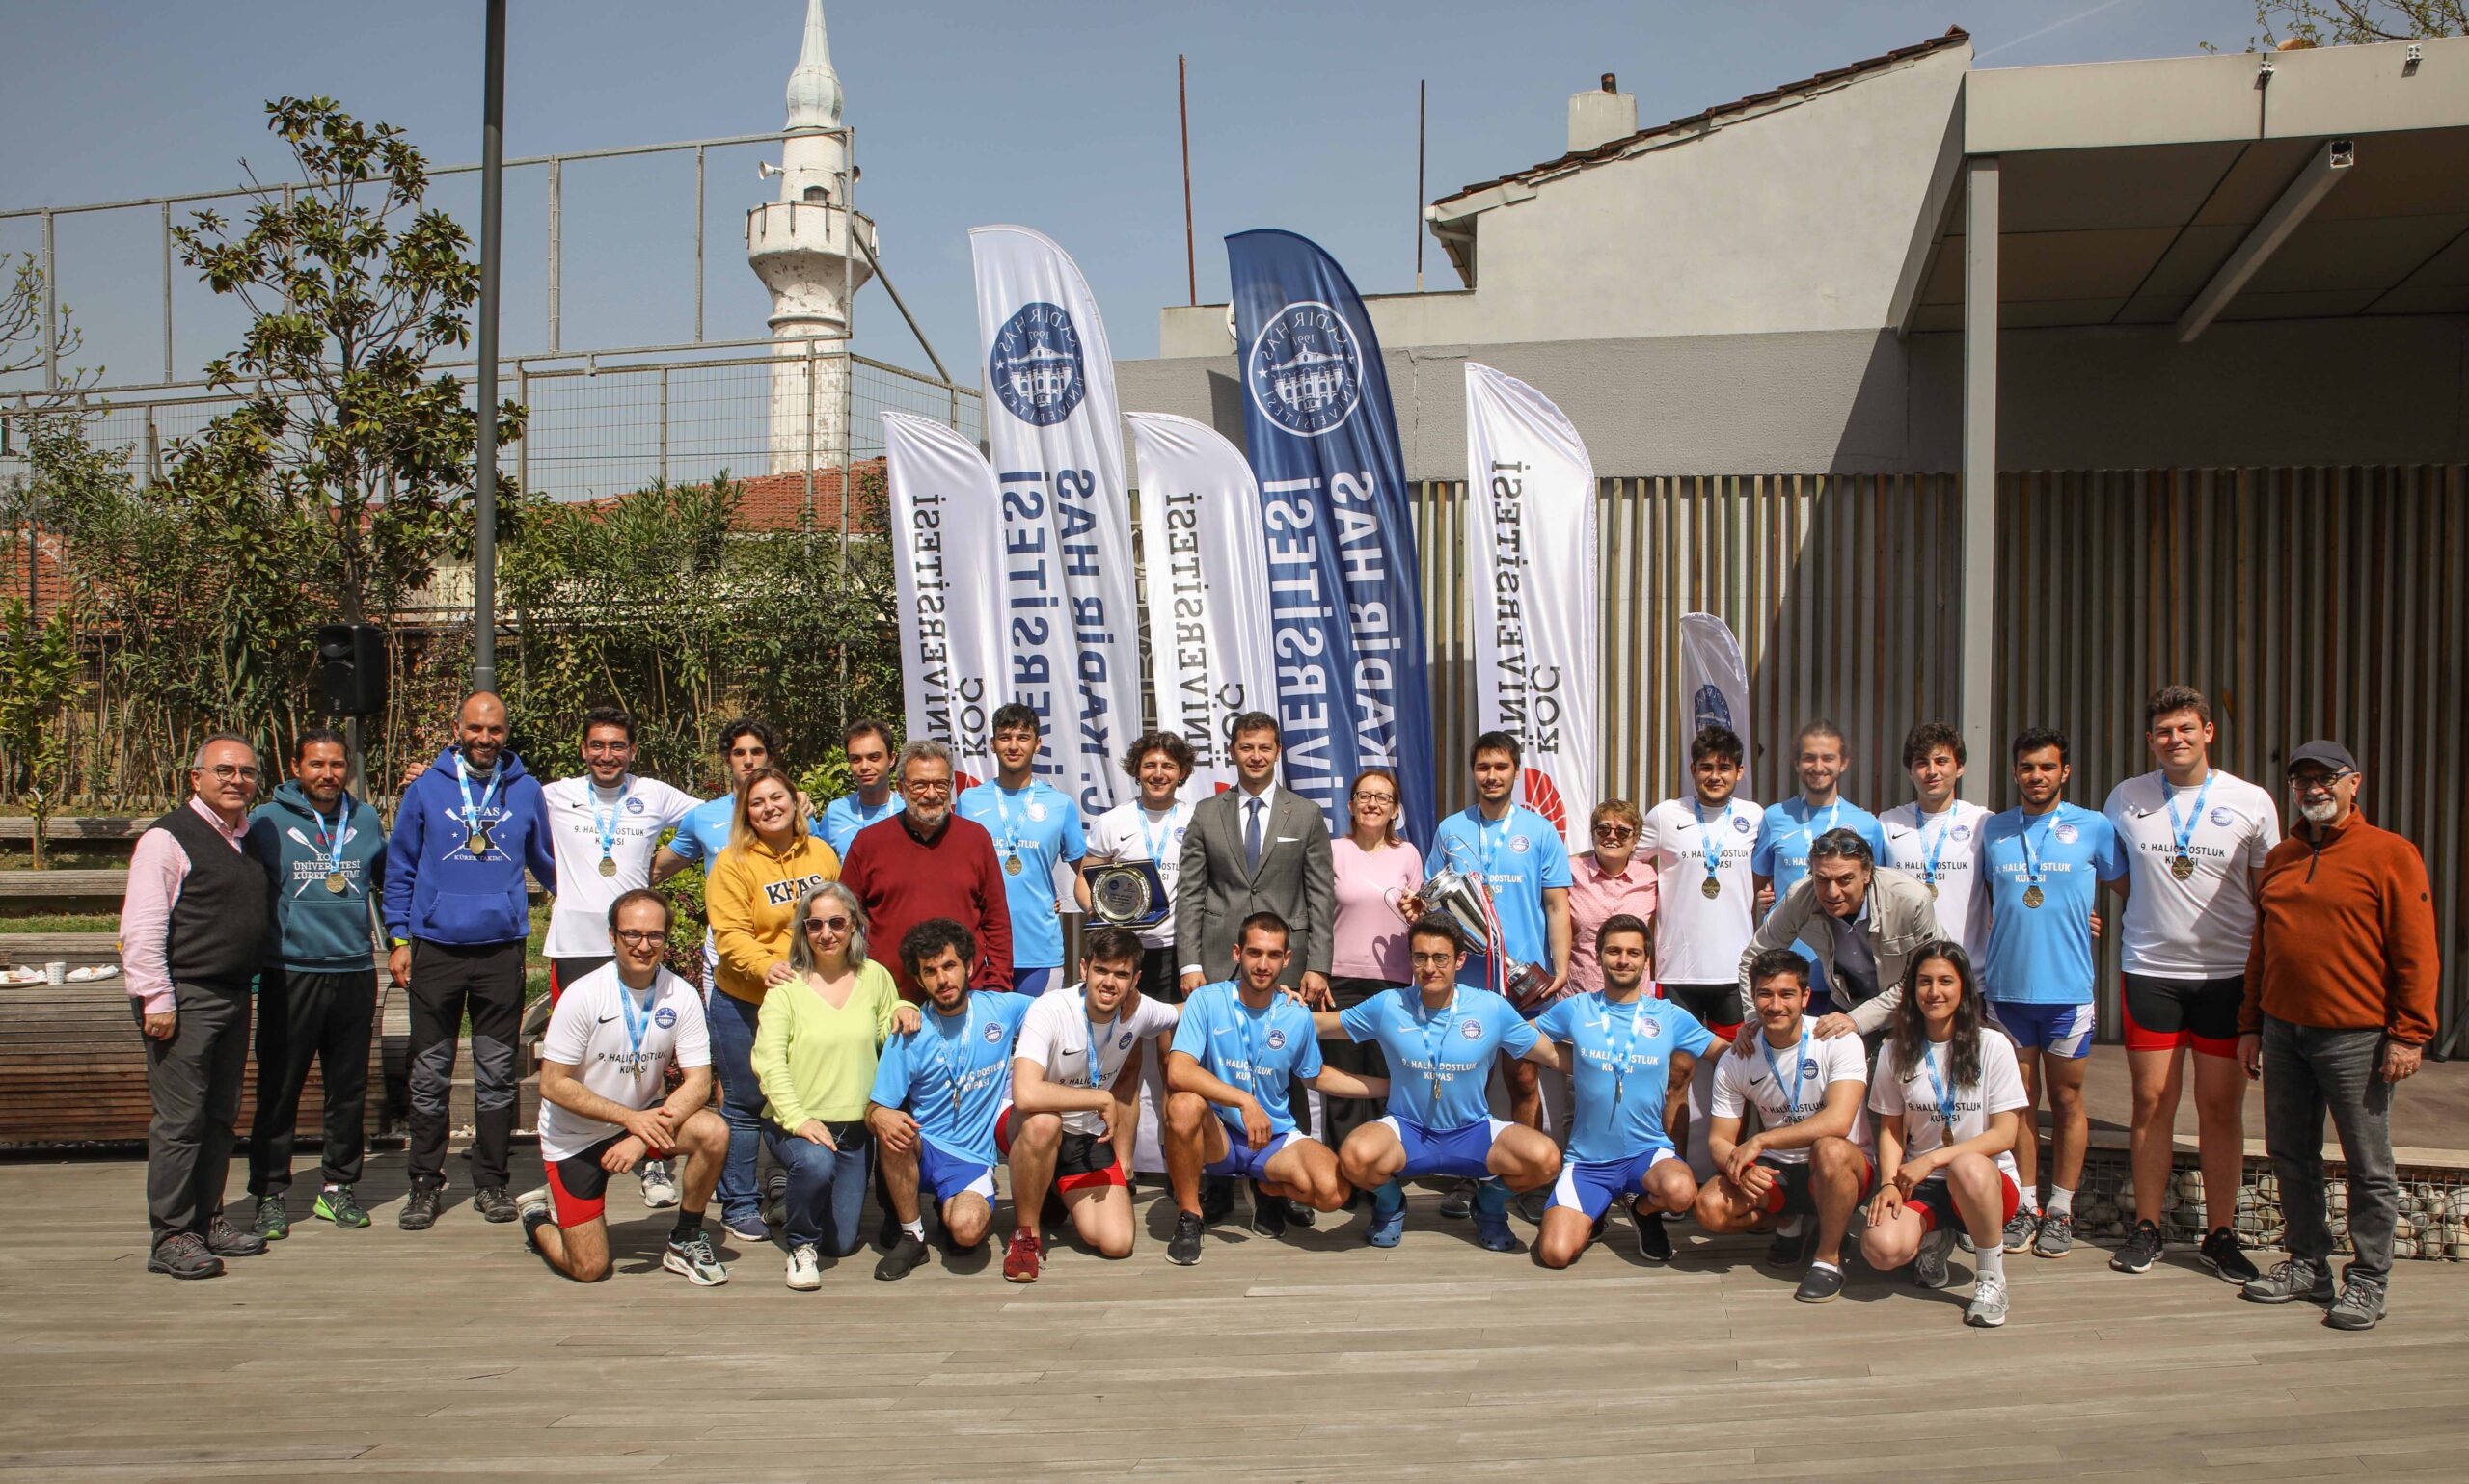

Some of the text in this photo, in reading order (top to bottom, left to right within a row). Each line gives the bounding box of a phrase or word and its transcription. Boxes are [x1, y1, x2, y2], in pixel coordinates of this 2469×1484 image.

[616, 827, 644, 836] OSTLUK
[2188, 846, 2225, 857] OSTLUK
[293, 859, 361, 870] ÜNİVERTESİ
[1793, 857, 1808, 866] HAL
[2165, 855, 2199, 865] KSI
[1937, 861, 1967, 870] OSTLUK
[2040, 863, 2072, 872] STLUK
[293, 870, 327, 879] KÜREK
[1489, 874, 1522, 883] DOSTLUK
[2015, 874, 2046, 882] KUPSI
[598, 1052, 606, 1061] 9.
[610, 1051, 634, 1064] HALİÇ
[1581, 1047, 1659, 1065] 9. HALİ DSTLUK
[619, 1065, 648, 1074] KUPSI
[1439, 1062, 1477, 1071] DOSTLUK
[1601, 1063, 1634, 1073] KUSI
[957, 1071, 975, 1085] ALİÇ
[1794, 1101, 1825, 1113] OSTLUK
[1952, 1102, 1982, 1111] STLUK
[1930, 1114, 1961, 1122] KUPSI
